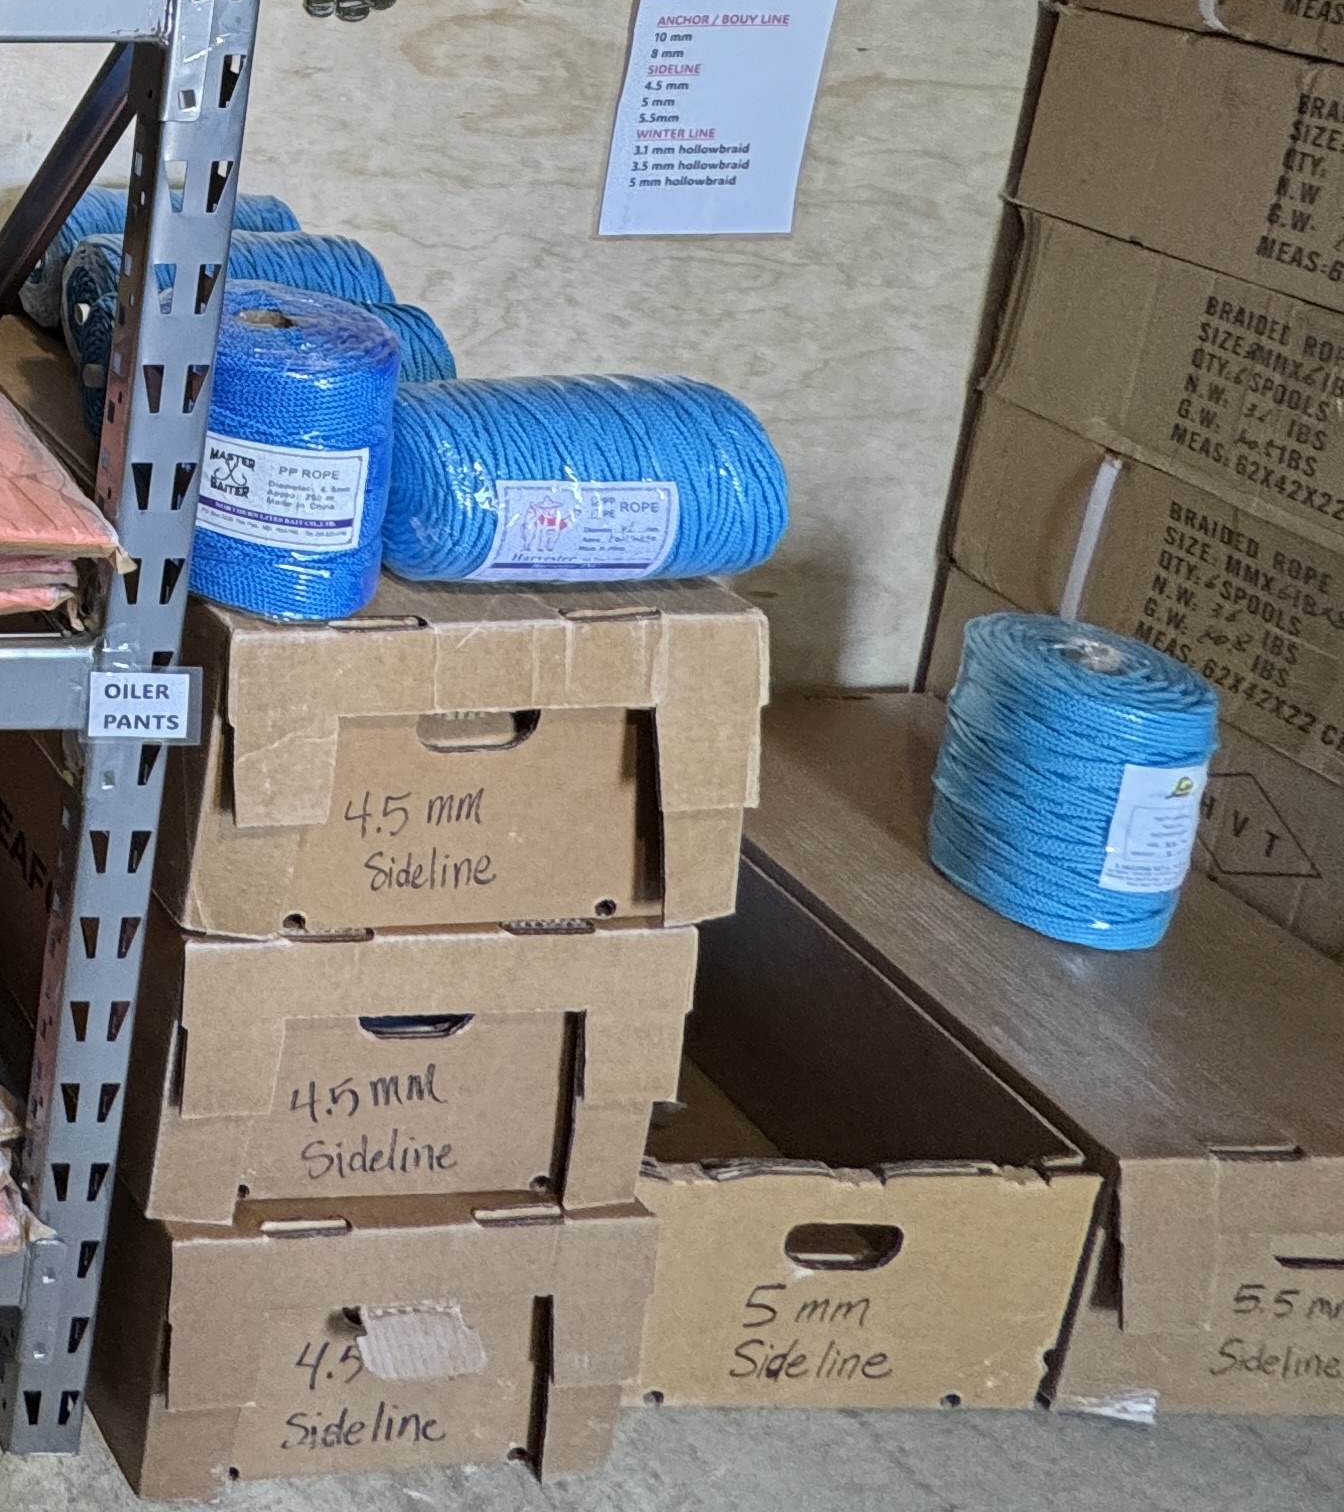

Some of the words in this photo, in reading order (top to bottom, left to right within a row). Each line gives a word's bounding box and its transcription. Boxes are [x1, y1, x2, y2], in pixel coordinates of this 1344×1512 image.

[656, 15, 710, 26] ANCHOR
[721, 14, 758, 25] BOUY
[761, 14, 790, 25] LINE
[654, 32, 667, 42] 10
[669, 33, 693, 42] mm
[650, 48, 658, 58] 8
[661, 50, 684, 58] mm
[647, 64, 701, 75] SIDELINE
[644, 80, 663, 90] 4.5
[665, 82, 689, 90] mm
[641, 97, 649, 107] 5
[652, 98, 675, 107] mm
[638, 113, 680, 123] 5.5mm
[636, 129, 686, 139] WINTER
[688, 128, 716, 139] LINE
[633, 145, 649, 155] 3.1
[652, 145, 675, 155] mm
[678, 143, 750, 155] hollowbraid
[631, 161, 649, 171] 3.5
[651, 162, 675, 171] mm
[677, 159, 750, 171] hollowbraid
[628, 177, 636, 187] 5
[639, 178, 662, 187] mm
[664, 175, 737, 187] hollowbraid
[209, 447, 256, 472] MASTER
[278, 465, 298, 477] PP
[301, 469, 340, 481] ROPE
[210, 474, 250, 499] BAITER
[619, 501, 659, 514] ROPE
[1168, 500, 1260, 560] BRAIDED
[1272, 550, 1333, 595] ROPE
[1220, 579, 1302, 637] SPOOLS
[103, 683, 171, 701] OILER
[102, 712, 180, 731] PANTS
[344, 789, 411, 838] 4.5
[426, 786, 486, 827] mm
[364, 849, 497, 890] Sideline
[288, 1079, 360, 1123] 4.5
[369, 1062, 448, 1107] mm
[301, 1128, 458, 1175] Sideline
[741, 1282, 787, 1327] 5
[795, 1296, 872, 1327] mm
[1233, 1283, 1300, 1318] 5.5
[728, 1339, 893, 1382] Sideline
[1208, 1337, 1341, 1381] Sideline
[280, 1400, 448, 1451] Sideline
